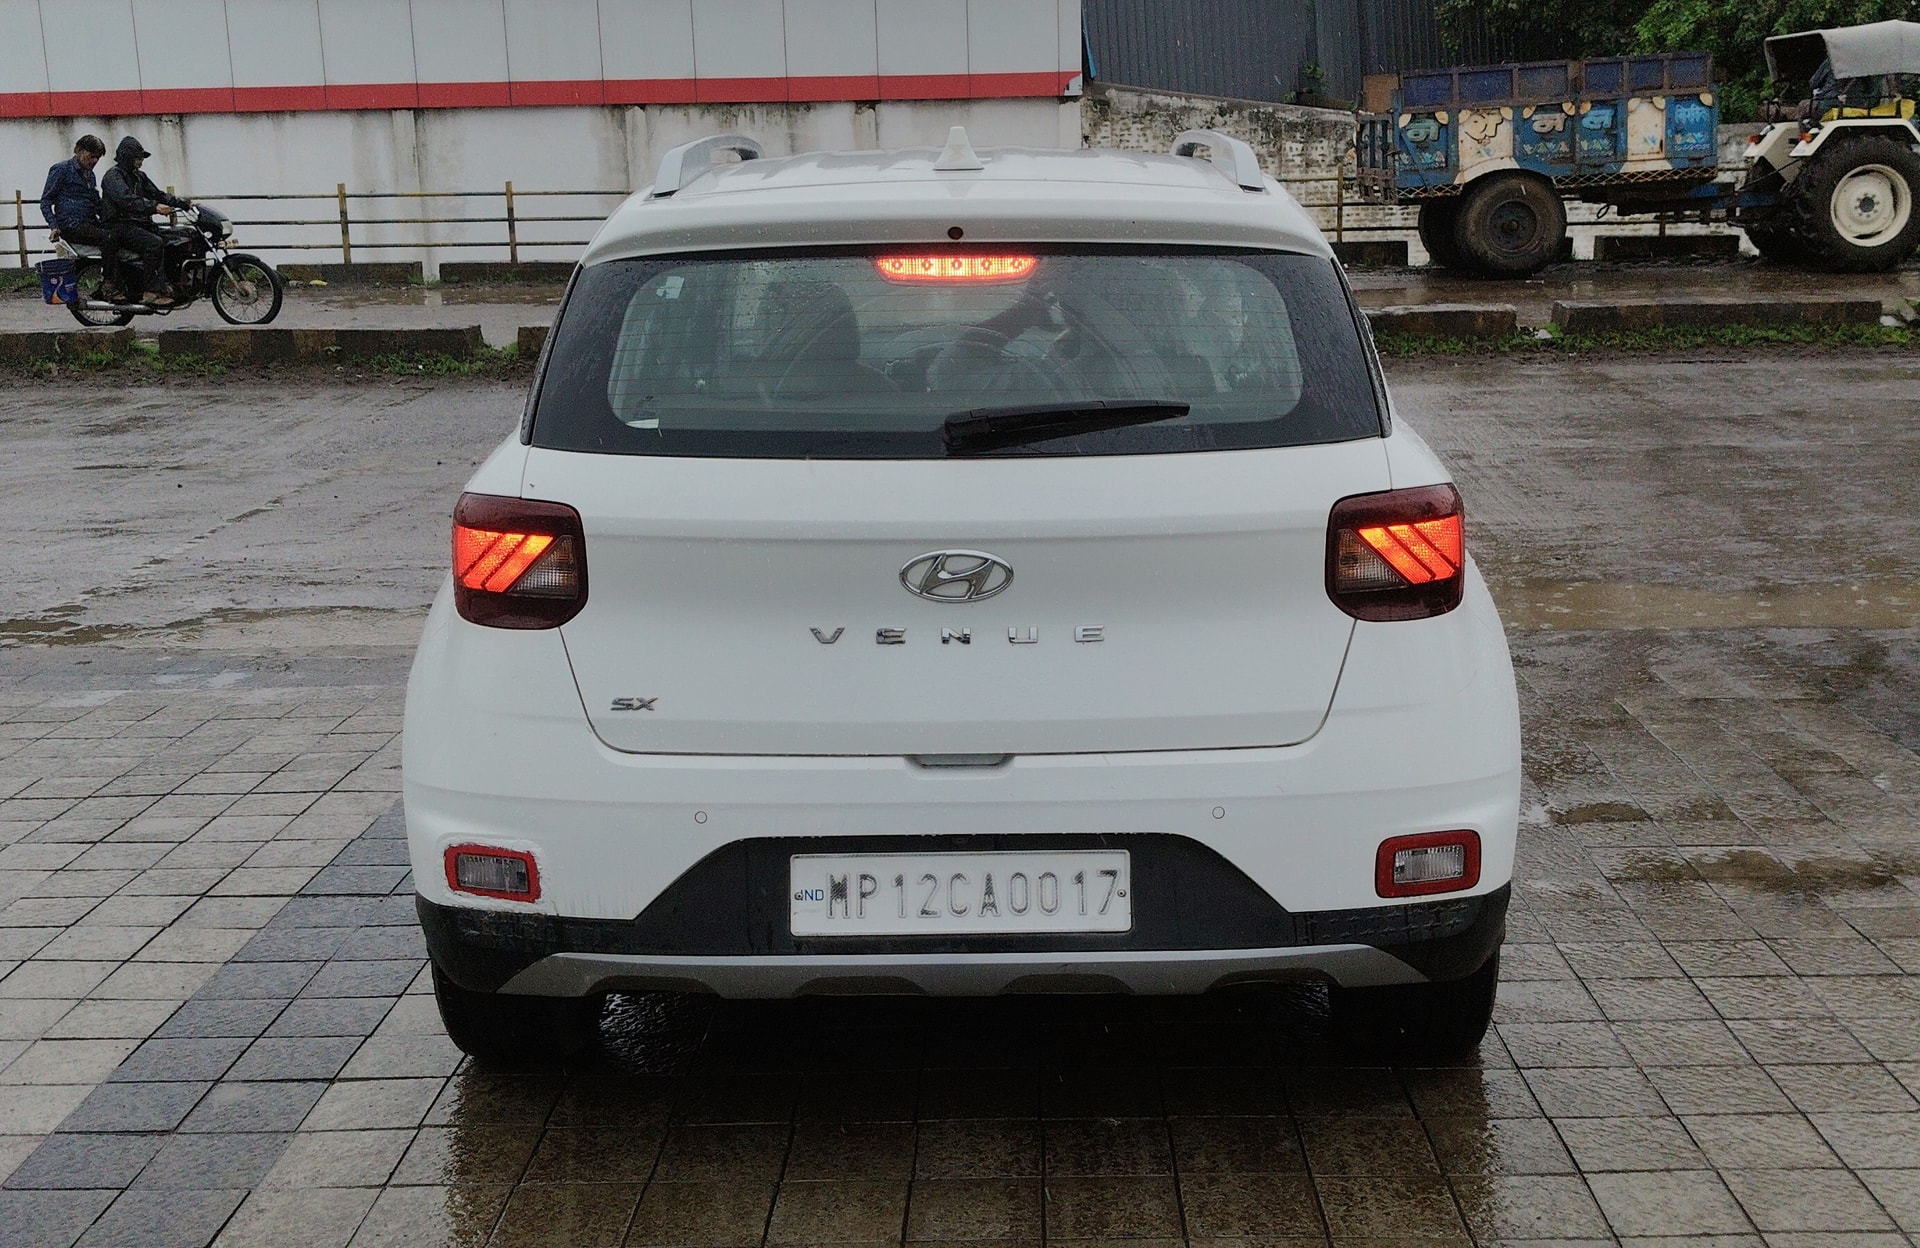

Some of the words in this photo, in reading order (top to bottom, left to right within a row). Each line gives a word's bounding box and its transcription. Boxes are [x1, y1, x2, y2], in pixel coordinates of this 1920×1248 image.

[809, 626, 1104, 645] VENUE
[610, 697, 659, 711] SX
[827, 869, 1119, 918] MP12CA0017
